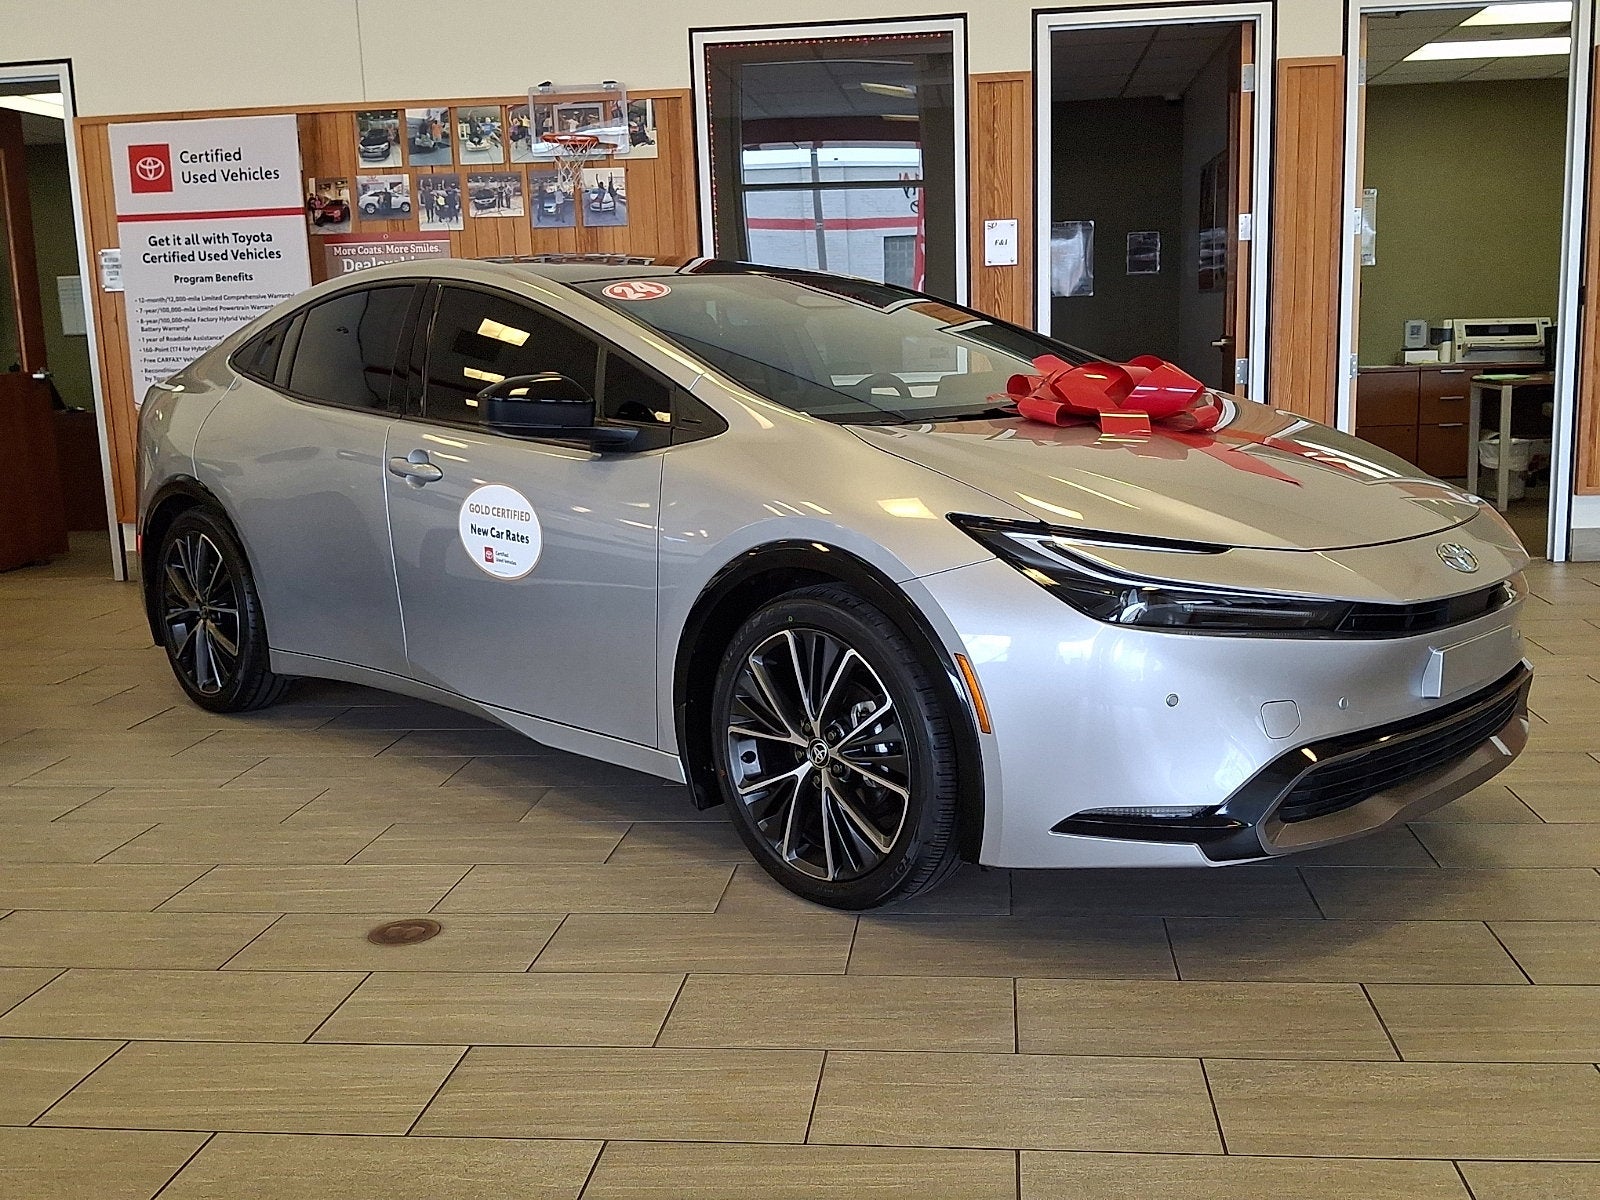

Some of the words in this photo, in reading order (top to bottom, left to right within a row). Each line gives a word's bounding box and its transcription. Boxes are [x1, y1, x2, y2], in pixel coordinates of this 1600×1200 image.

[180, 147, 242, 163] Certified
[182, 169, 217, 183] Used
[221, 167, 279, 181] Vehicles
[148, 235, 170, 246] Get
[173, 234, 181, 245] it
[185, 233, 200, 245] all
[202, 233, 229, 244] with
[232, 232, 272, 246] Toyota
[142, 250, 195, 263] Certified
[198, 249, 228, 261] Used
[231, 248, 282, 260] Vehicles
[334, 246, 356, 256] More
[357, 246, 384, 255] Coats.
[386, 245, 408, 254] More
[410, 244, 441, 253] Smiles.
[174, 275, 213, 285] Program
[216, 272, 253, 282] Benefits
[469, 503, 490, 515] GOLD
[492, 507, 530, 521] CERTIFIED
[471, 523, 488, 536] New
[490, 527, 504, 539] Car
[506, 530, 529, 544] Rates
